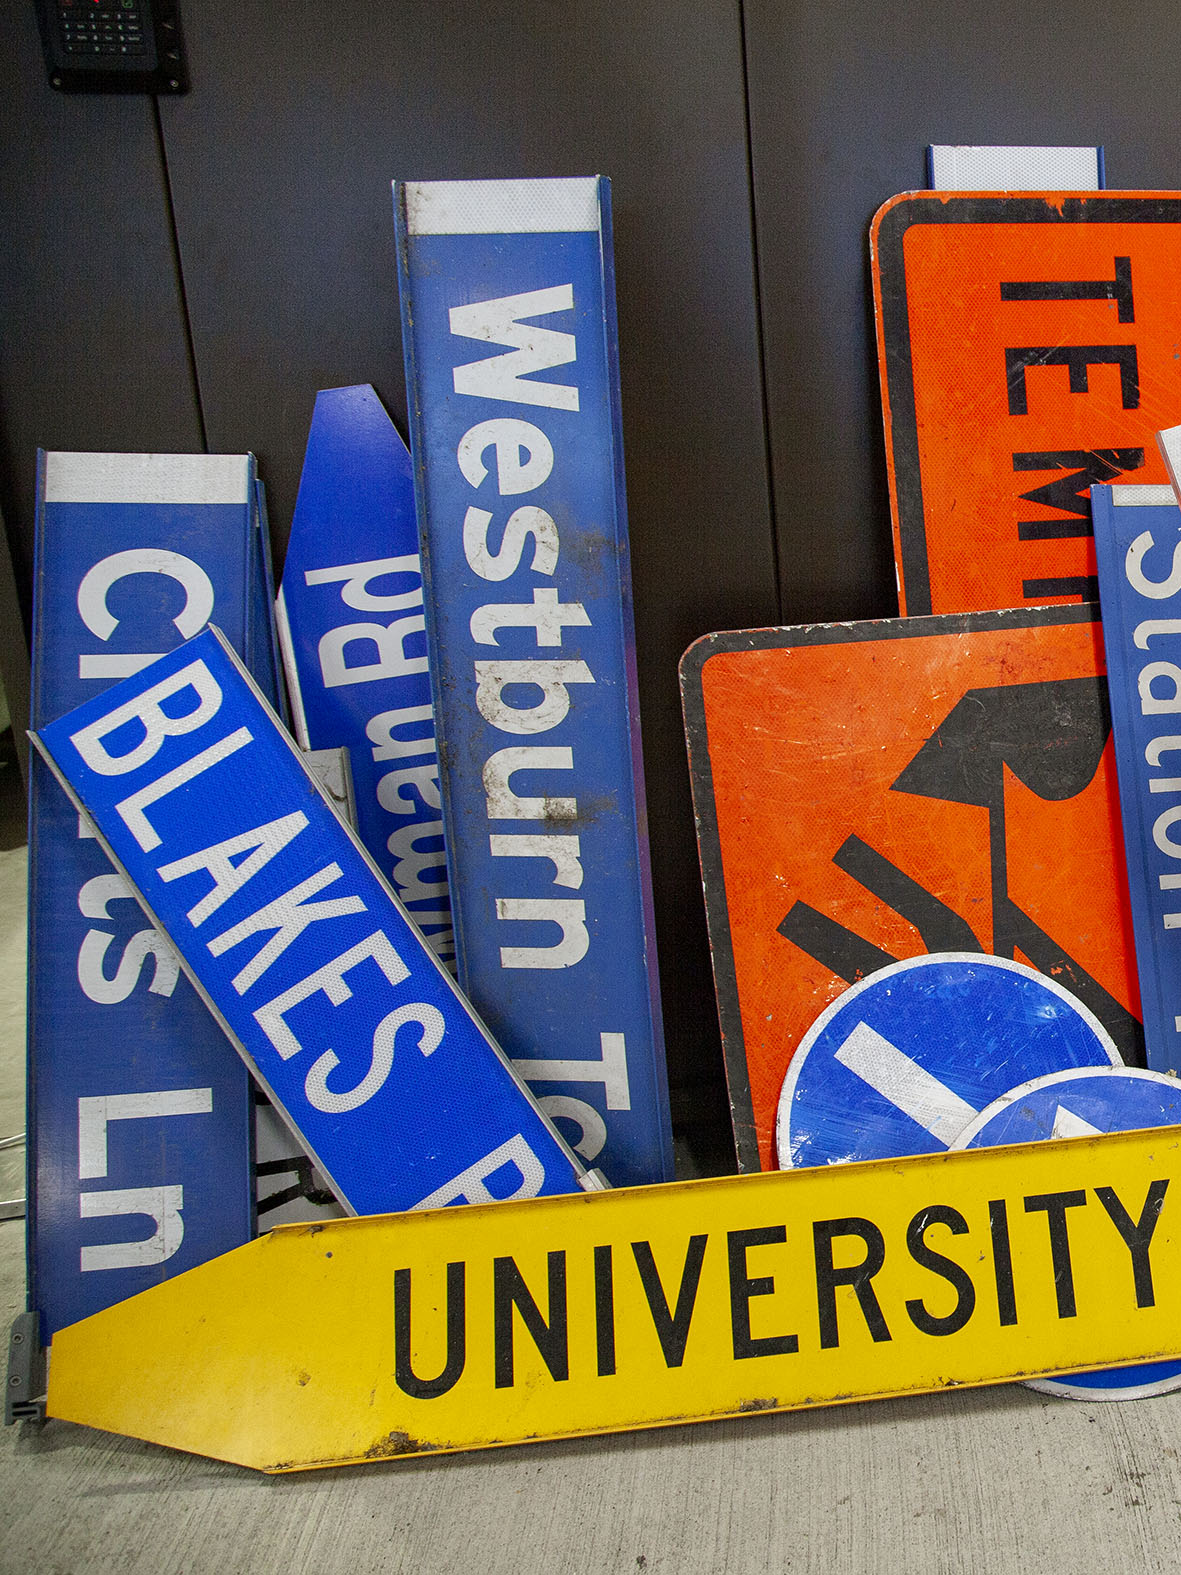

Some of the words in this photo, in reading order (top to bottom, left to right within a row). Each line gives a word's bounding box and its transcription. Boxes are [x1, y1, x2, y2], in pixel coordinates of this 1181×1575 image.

[448, 283, 595, 970] Westburn
[69, 657, 447, 1114] BLAKES
[78, 1087, 214, 1273] Ln
[393, 1178, 1171, 1401] UNIVERSITY
